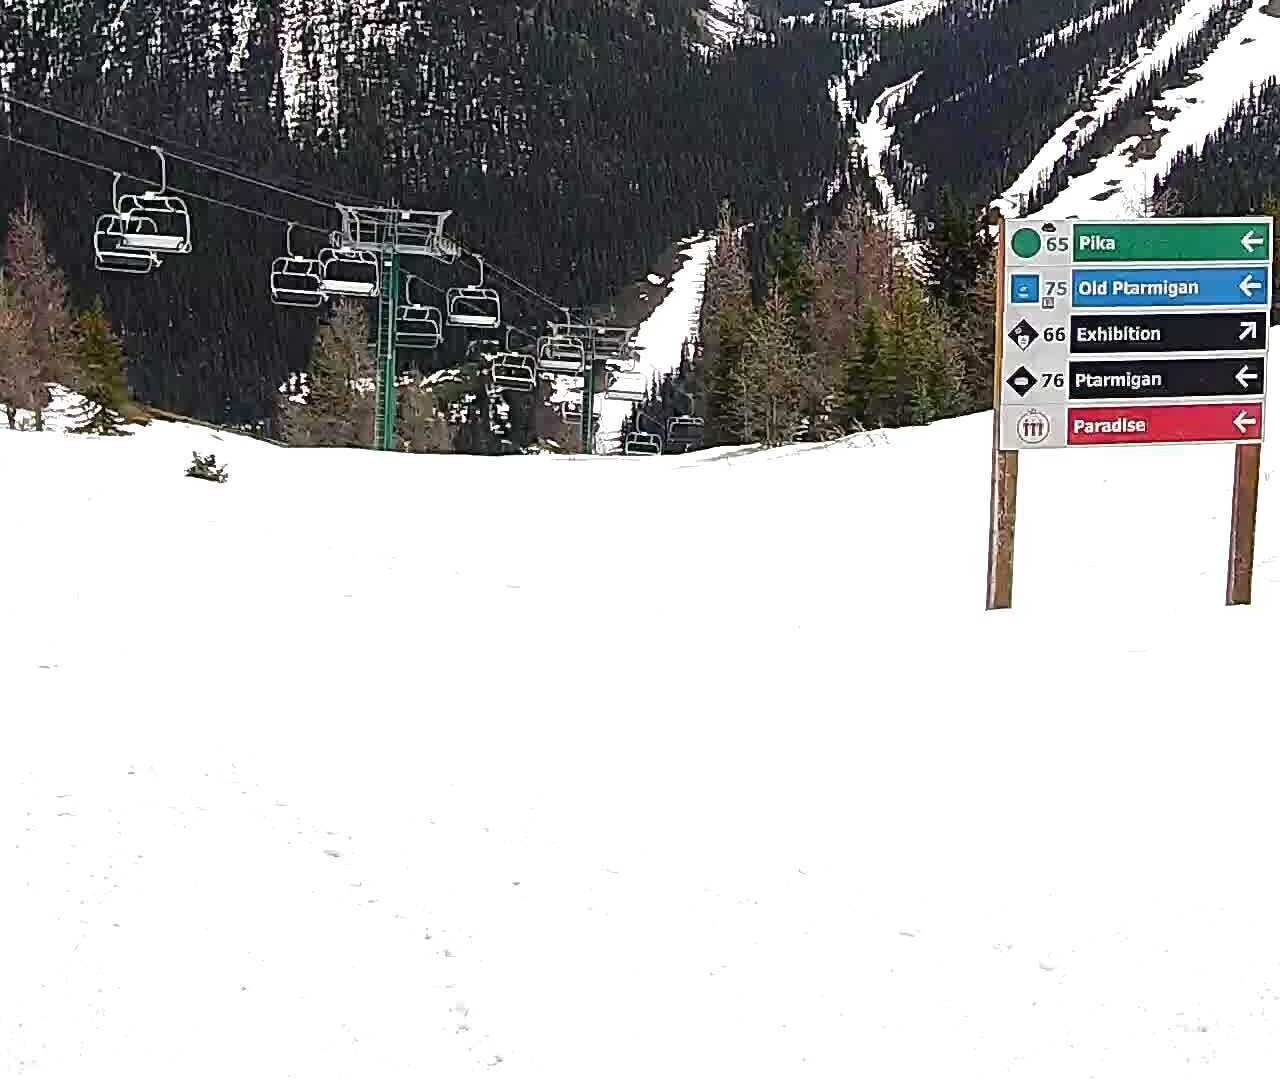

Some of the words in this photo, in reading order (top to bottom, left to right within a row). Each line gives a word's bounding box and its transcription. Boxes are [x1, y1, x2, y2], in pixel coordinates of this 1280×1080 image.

[1046, 237, 1069, 252] 65
[1079, 235, 1116, 251] Pika
[1045, 281, 1068, 296] 75
[1079, 281, 1108, 296] Old
[1112, 280, 1199, 298] Ptarmigan
[1043, 327, 1066, 342] 66
[1077, 326, 1161, 342] Exhibition
[1042, 373, 1065, 388] 76
[1075, 372, 1162, 390] Ptarmigan
[1073, 418, 1147, 434] Paradise
